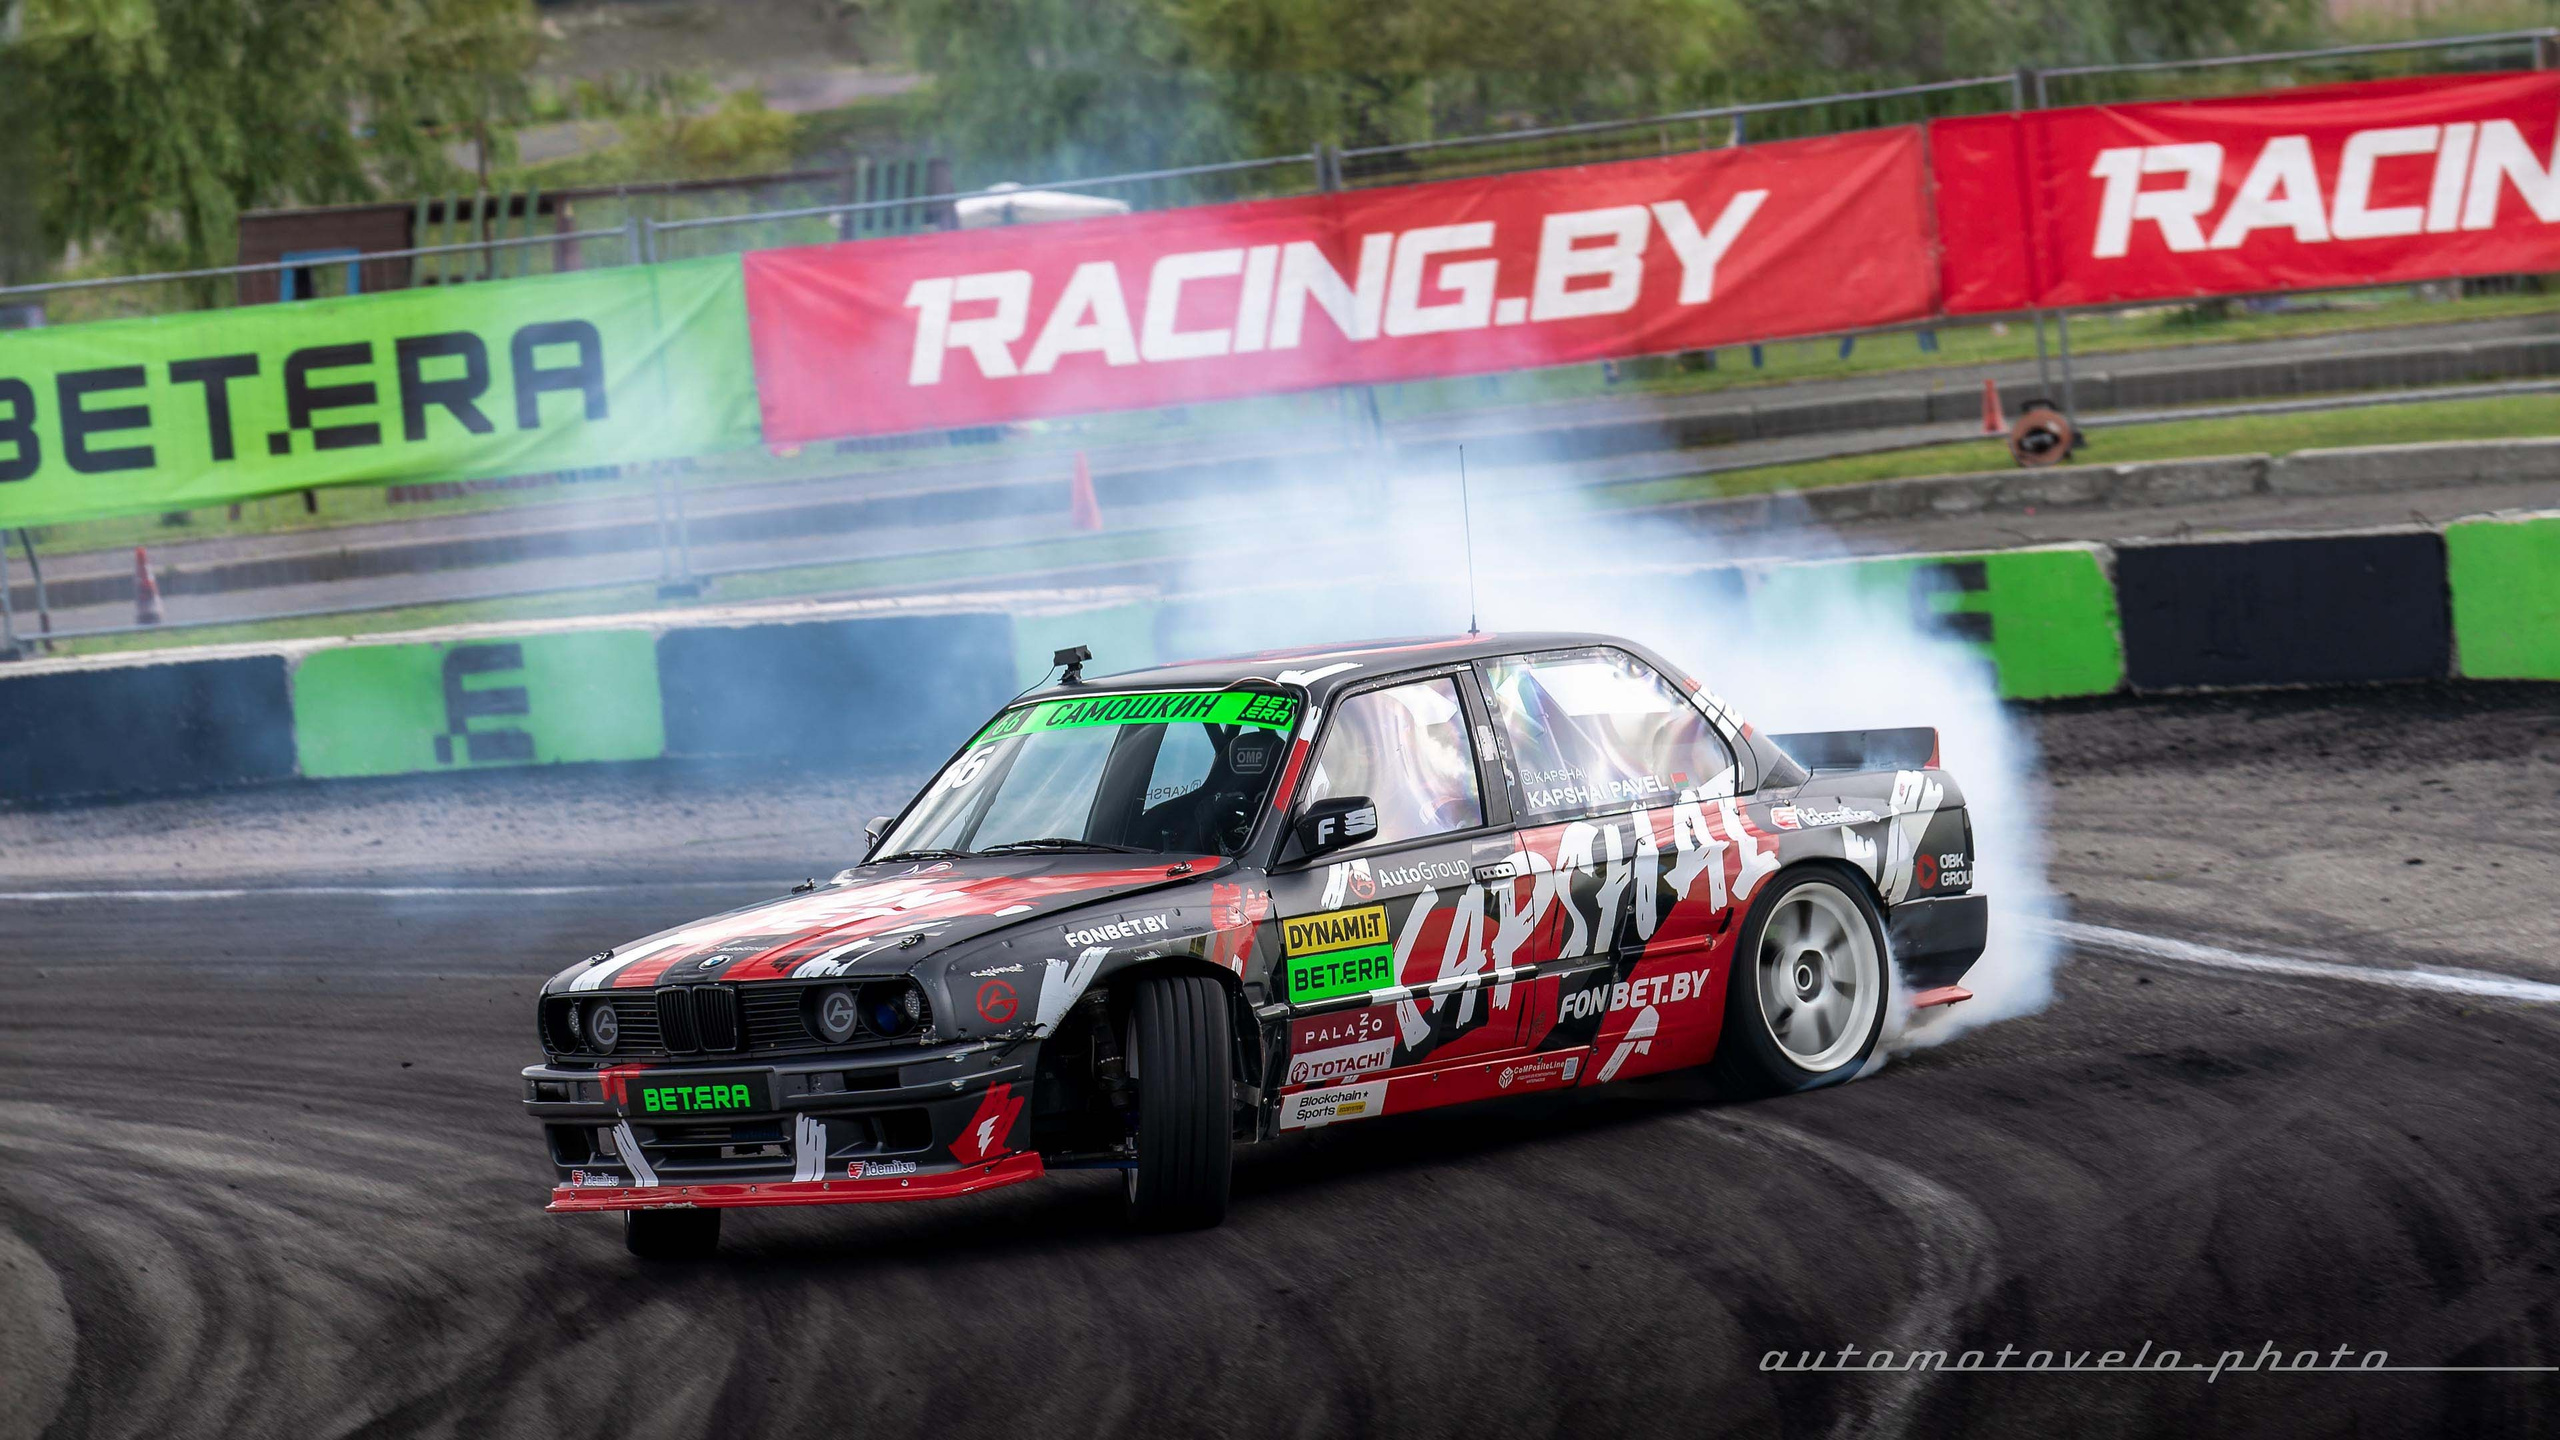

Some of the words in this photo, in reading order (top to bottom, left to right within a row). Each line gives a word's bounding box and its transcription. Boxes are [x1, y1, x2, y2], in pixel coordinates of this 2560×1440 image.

[903, 189, 1770, 386] RACING.BY
[1045, 693, 1223, 727] САМОШКИН
[1236, 751, 1263, 764] OMP
[1527, 783, 1608, 809] KAPSHAI
[1608, 774, 1670, 799] PAVEL
[1379, 859, 1470, 888] AutoGroup
[1939, 852, 1965, 869] OBK
[1065, 914, 1170, 948] FONBET.BY
[1558, 968, 1711, 1024] FONBET.BY
[1311, 1051, 1385, 1078] TOTACHI
[1300, 1090, 1362, 1108] Blockchain
[1297, 1105, 1336, 1122] Sports
[865, 1159, 917, 1177] idemitsu
